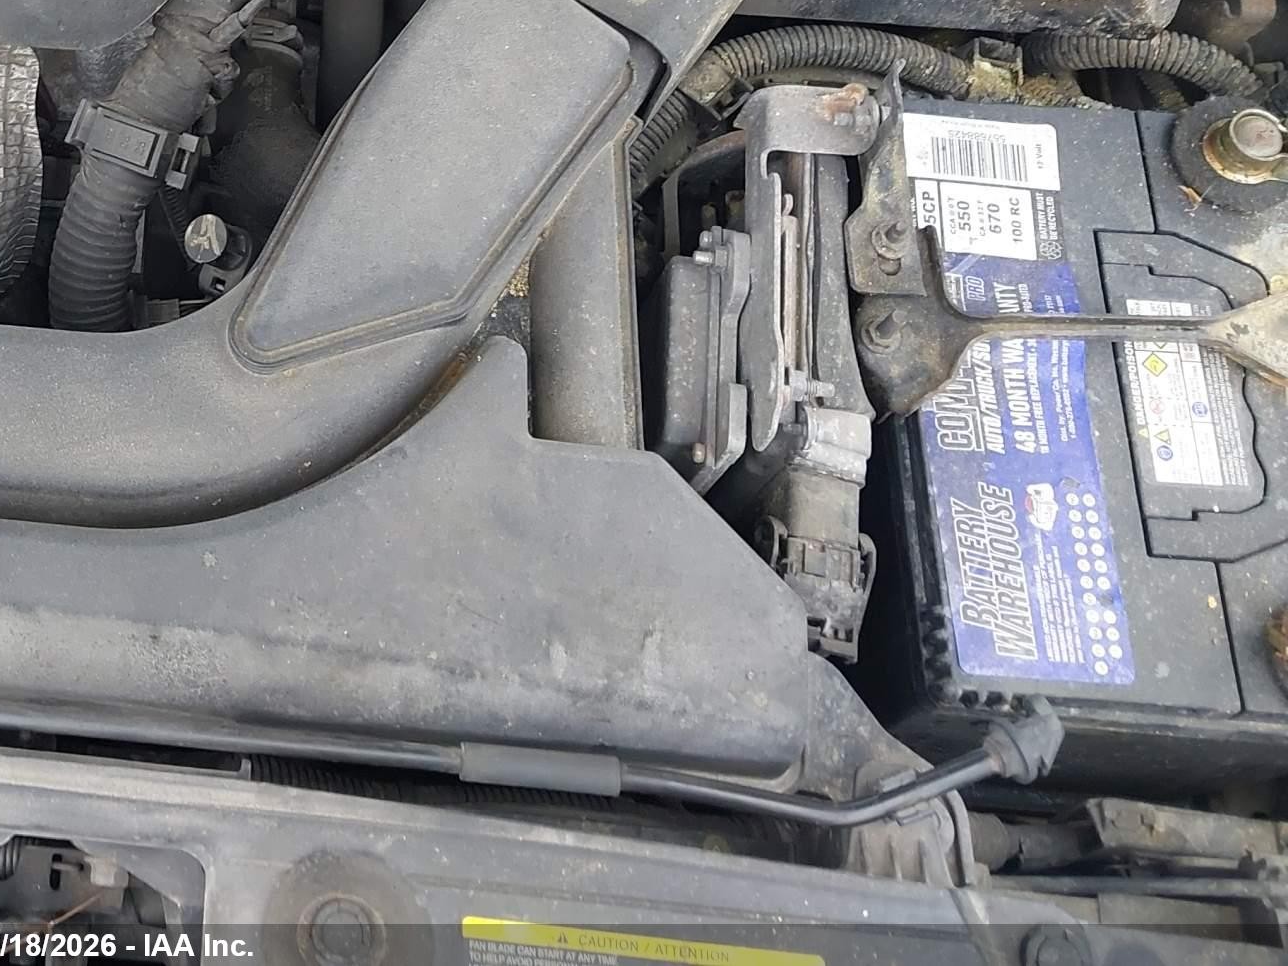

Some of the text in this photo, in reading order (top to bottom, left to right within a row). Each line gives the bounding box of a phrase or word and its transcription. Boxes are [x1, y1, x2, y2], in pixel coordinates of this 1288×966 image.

[922, 191, 937, 225] 5CP
[957, 201, 971, 232] 550
[987, 203, 1002, 234] 670
[1009, 197, 1023, 243] 100 RC
[1035, 192, 1048, 240] BATTERY MUST
[1045, 196, 1057, 232] RECYCLED
[965, 275, 986, 301] PRO
[1027, 352, 1041, 402] REPLACEMENT
[1003, 368, 1033, 426] MONTH
[1032, 401, 1044, 419] FREE
[1014, 430, 1037, 453] 48
[1036, 420, 1049, 445] MONTH
[950, 497, 999, 628] BATTERY
[977, 482, 1038, 661] WAREHOUSE
[469, 940, 486, 951] FAN
[488, 941, 515, 955] BLADE
[517, 945, 536, 958] CAN
[538, 947, 565, 961] START
[566, 950, 576, 961] AT
[578, 952, 596, 964] ANY
[469, 950, 481, 963] TO
[483, 952, 505, 965] HELP
[578, 935, 639, 953] CAUTION
[654, 943, 730, 963] ATTENTION
